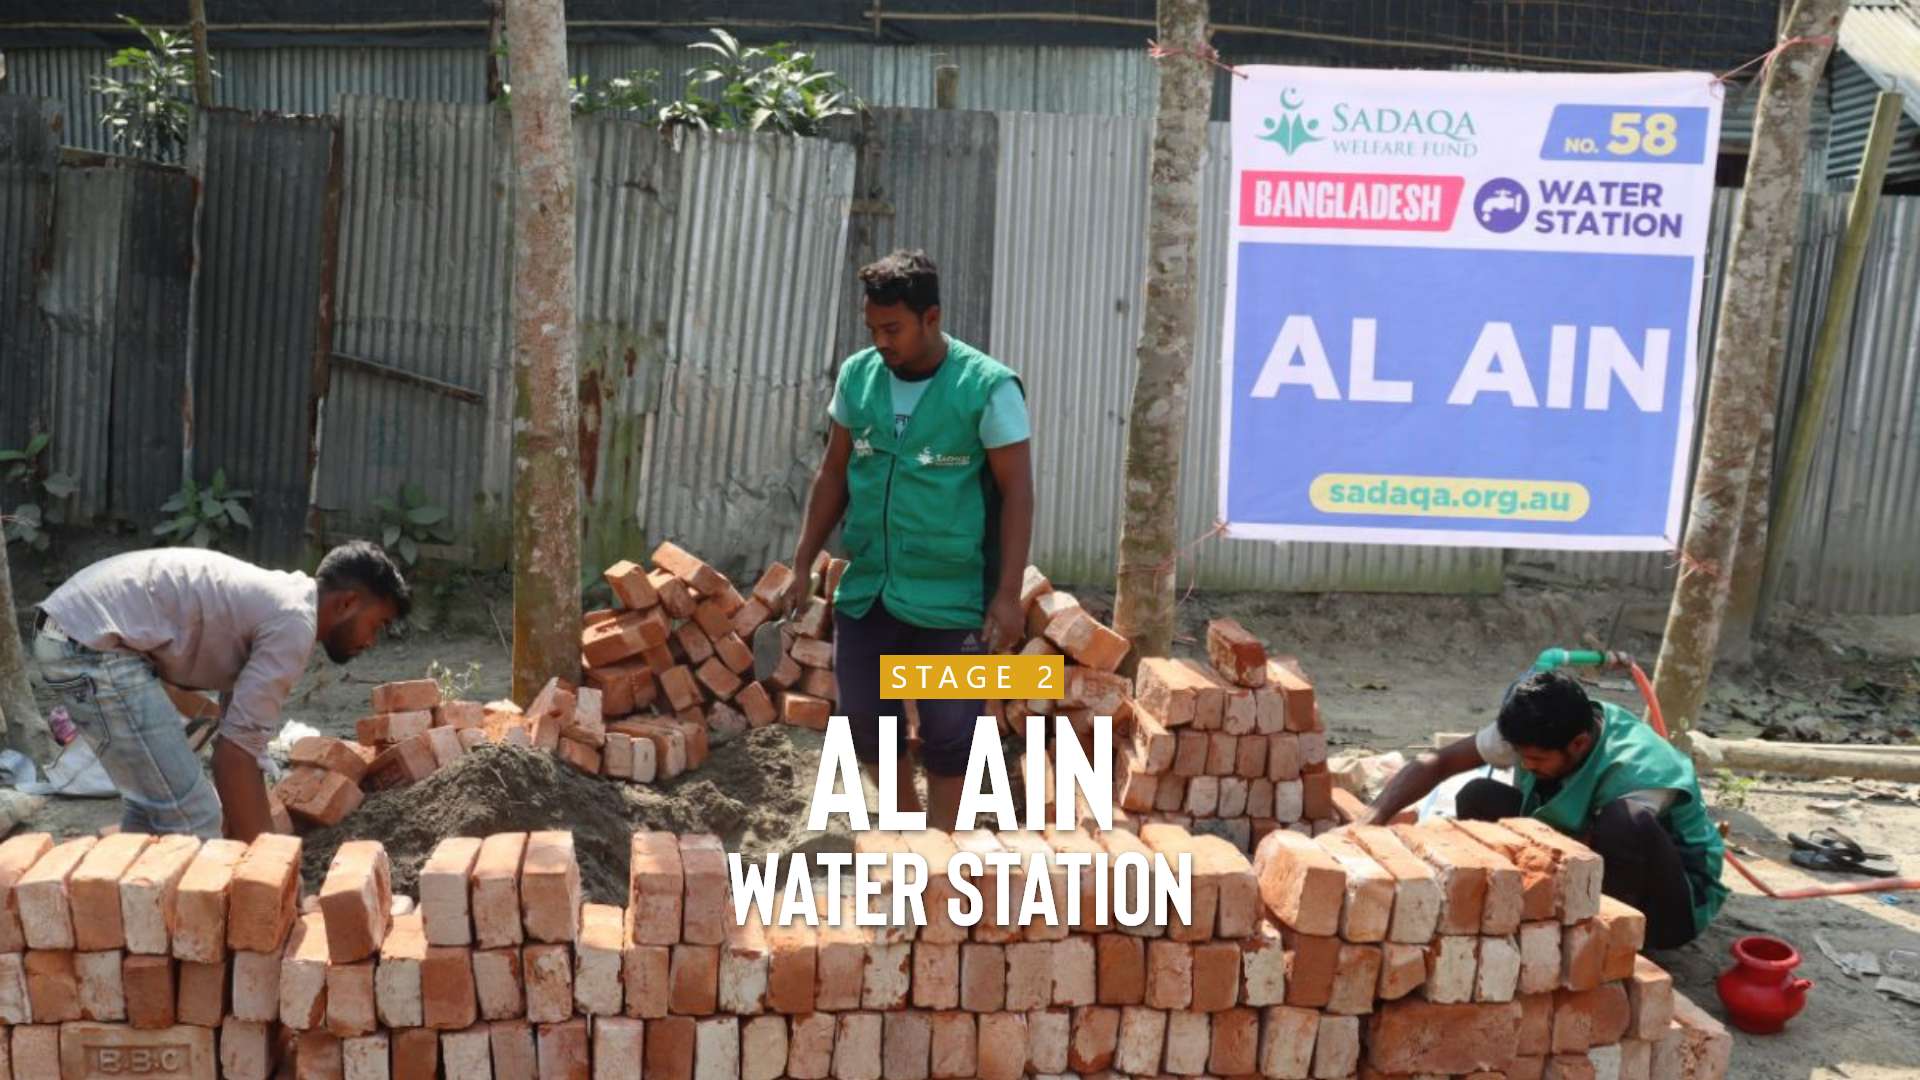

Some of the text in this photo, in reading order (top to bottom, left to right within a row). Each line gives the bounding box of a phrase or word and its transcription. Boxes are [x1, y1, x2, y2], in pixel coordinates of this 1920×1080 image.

[1332, 103, 1476, 141] SADAQA
[1565, 112, 1678, 156] NO. 58
[1333, 140, 1478, 158] WELFARE FUND
[1254, 180, 1442, 222] BANGLADESH
[1539, 179, 1663, 207] WATER
[1535, 209, 1683, 238] STATION
[1250, 314, 1672, 413] AL AIN
[1328, 479, 1572, 515] sadaqa.org.au
